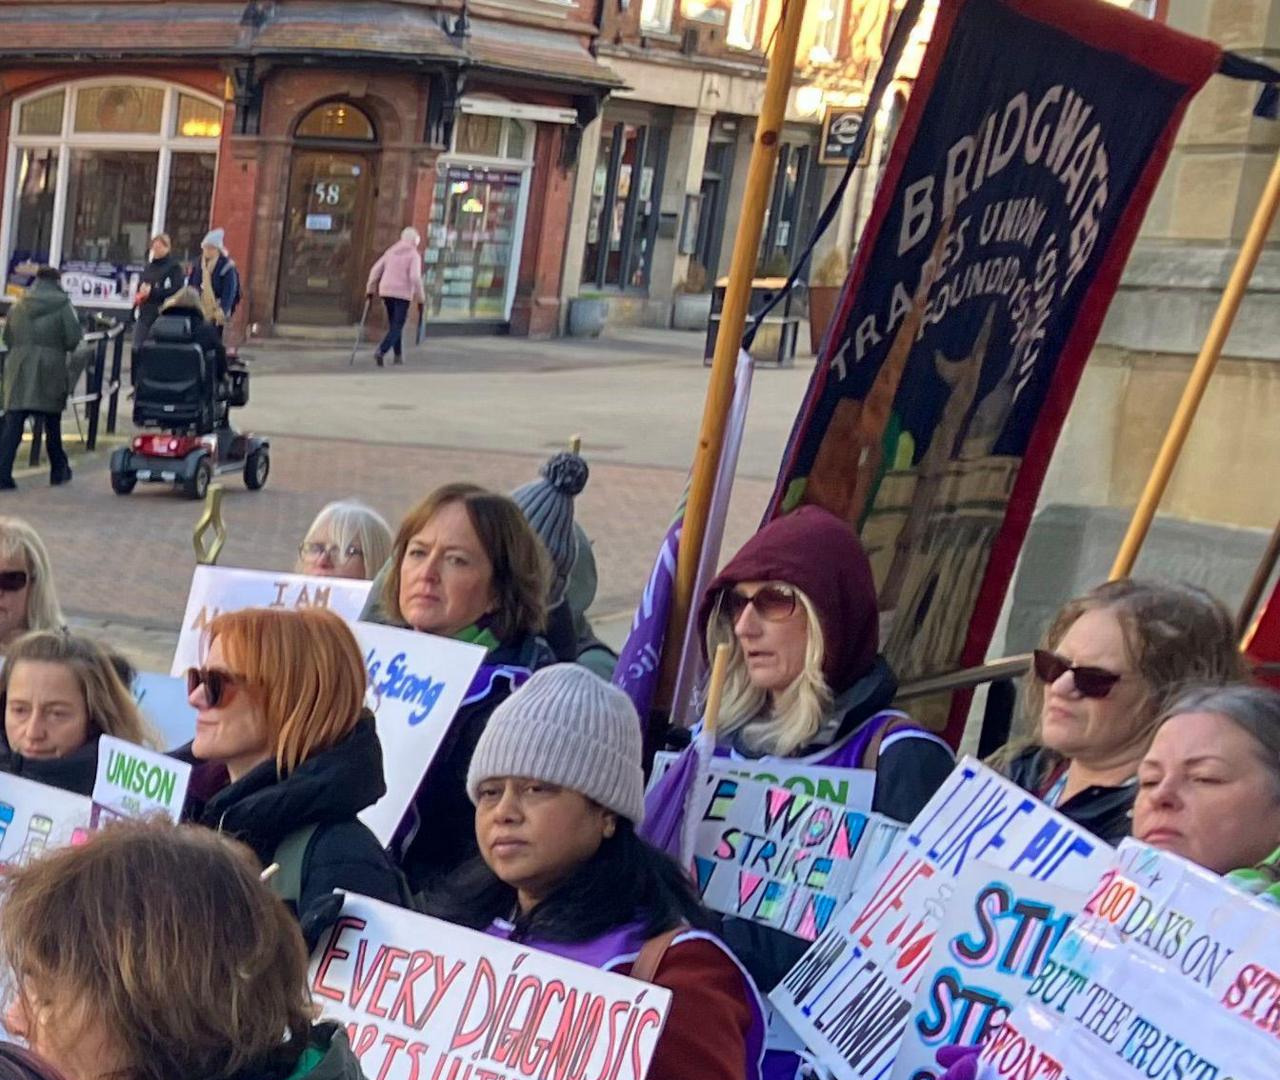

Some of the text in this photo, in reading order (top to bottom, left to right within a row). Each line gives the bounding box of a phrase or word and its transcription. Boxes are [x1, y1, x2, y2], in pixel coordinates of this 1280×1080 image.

[315, 183, 340, 205] 58
[979, 197, 1049, 250] UNION
[385, 652, 446, 727] Strong
[106, 747, 177, 806] UNISON
[713, 827, 834, 891] STRIKE
[765, 786, 871, 860] WON
[737, 869, 838, 944] VEIN
[1083, 868, 1138, 925] 200
[1120, 893, 1195, 961] DAYS
[1181, 934, 1235, 989] ON
[312, 915, 466, 1031] EVERY
[1026, 957, 1090, 1014] BUT
[1075, 982, 1136, 1045] THE
